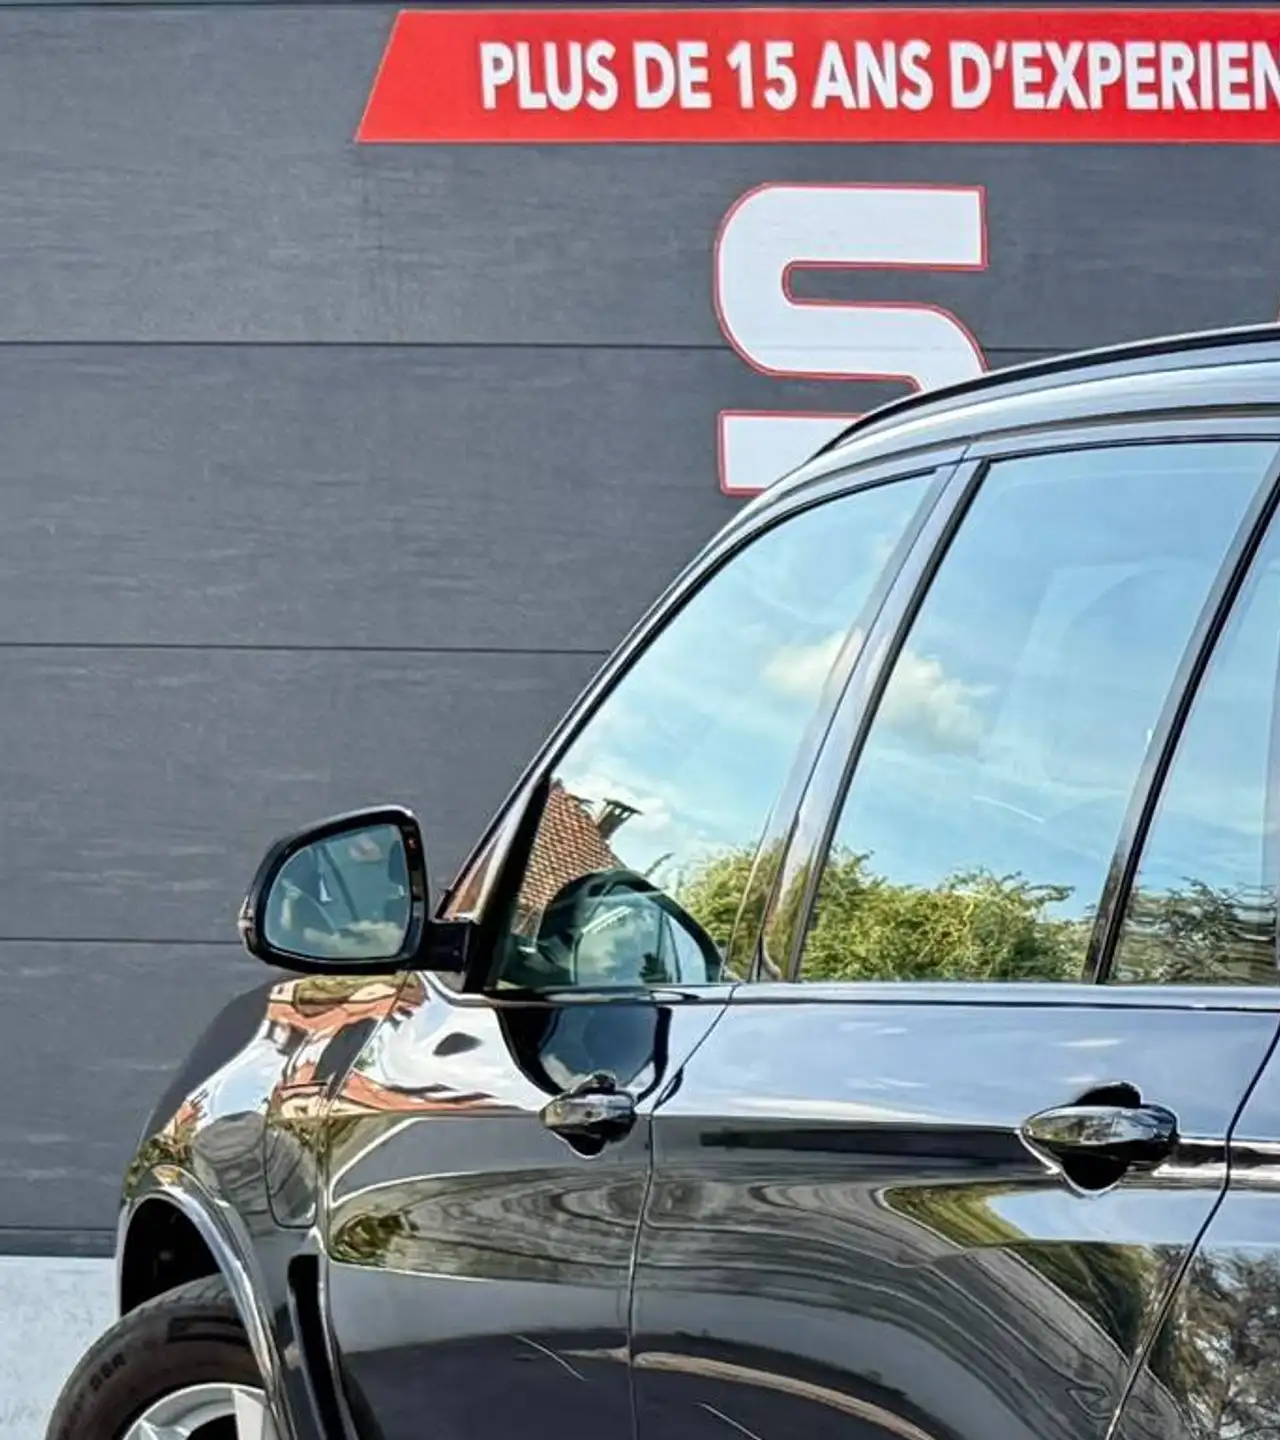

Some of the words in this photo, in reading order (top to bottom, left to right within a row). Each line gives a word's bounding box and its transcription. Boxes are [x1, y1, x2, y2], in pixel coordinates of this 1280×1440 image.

[480, 39, 619, 111] PLUS
[633, 40, 711, 110] DE
[727, 40, 798, 111] 15
[811, 39, 933, 111] ANS
